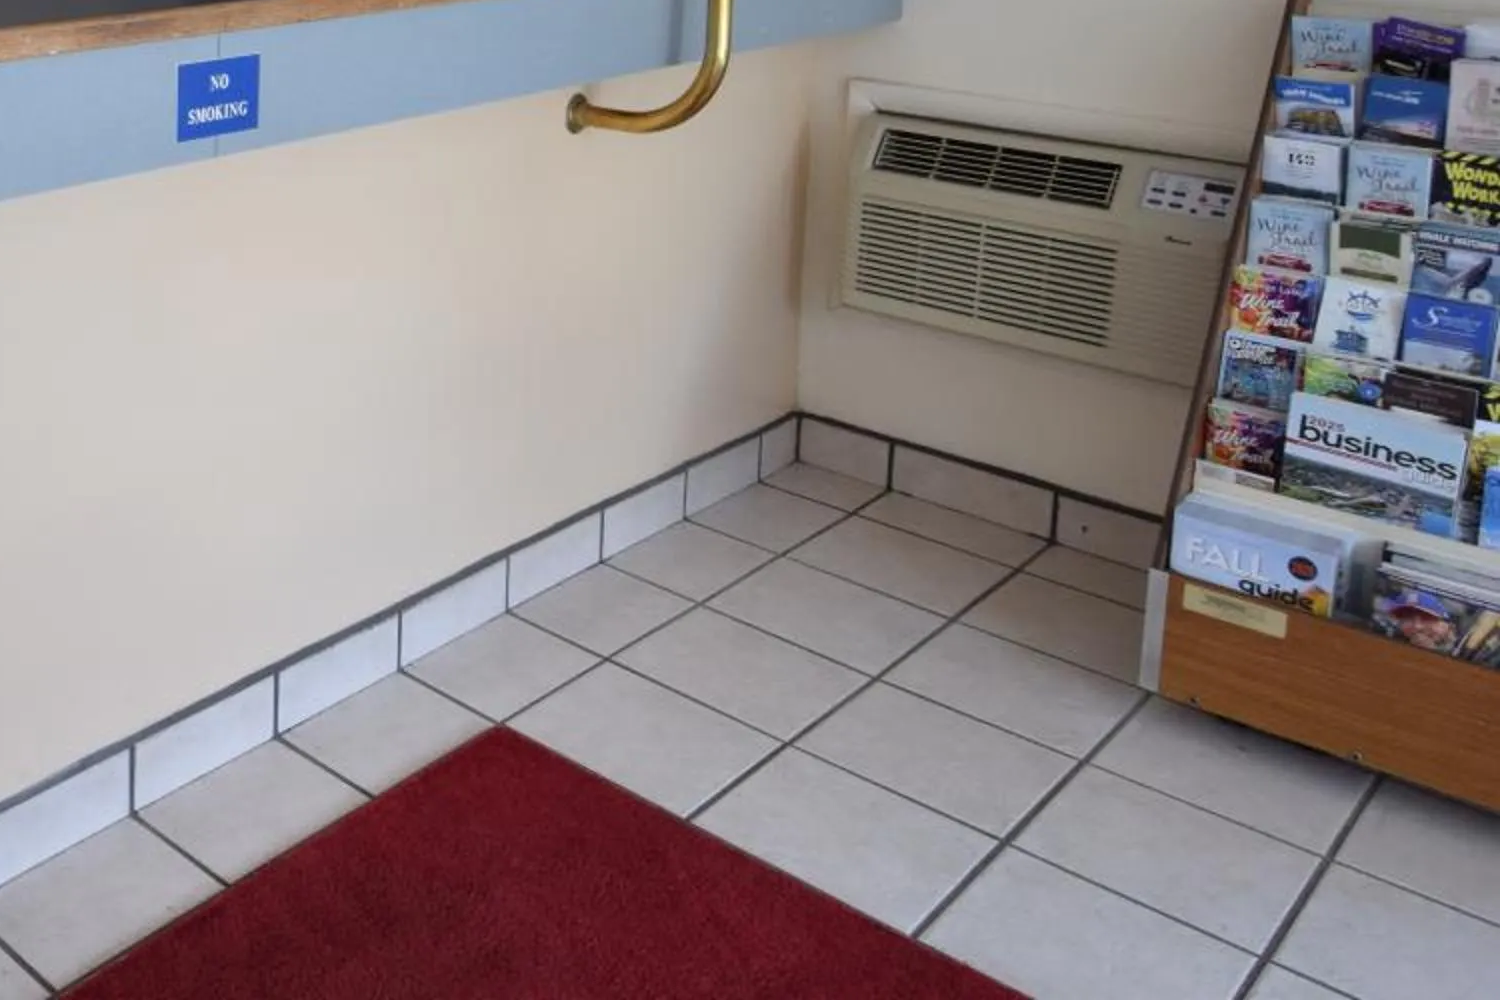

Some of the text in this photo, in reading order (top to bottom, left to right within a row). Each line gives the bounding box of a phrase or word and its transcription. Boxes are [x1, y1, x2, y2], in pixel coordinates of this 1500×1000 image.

[1299, 28, 1346, 43] Wine
[210, 72, 229, 92] NO
[187, 99, 248, 125] SMOKING
[1356, 165, 1401, 180] Wine
[1257, 216, 1300, 232] Wine
[1240, 291, 1285, 310] Wine
[1308, 415, 1345, 432] 2025
[1299, 413, 1457, 480] business
[1187, 537, 1269, 582] FALL
